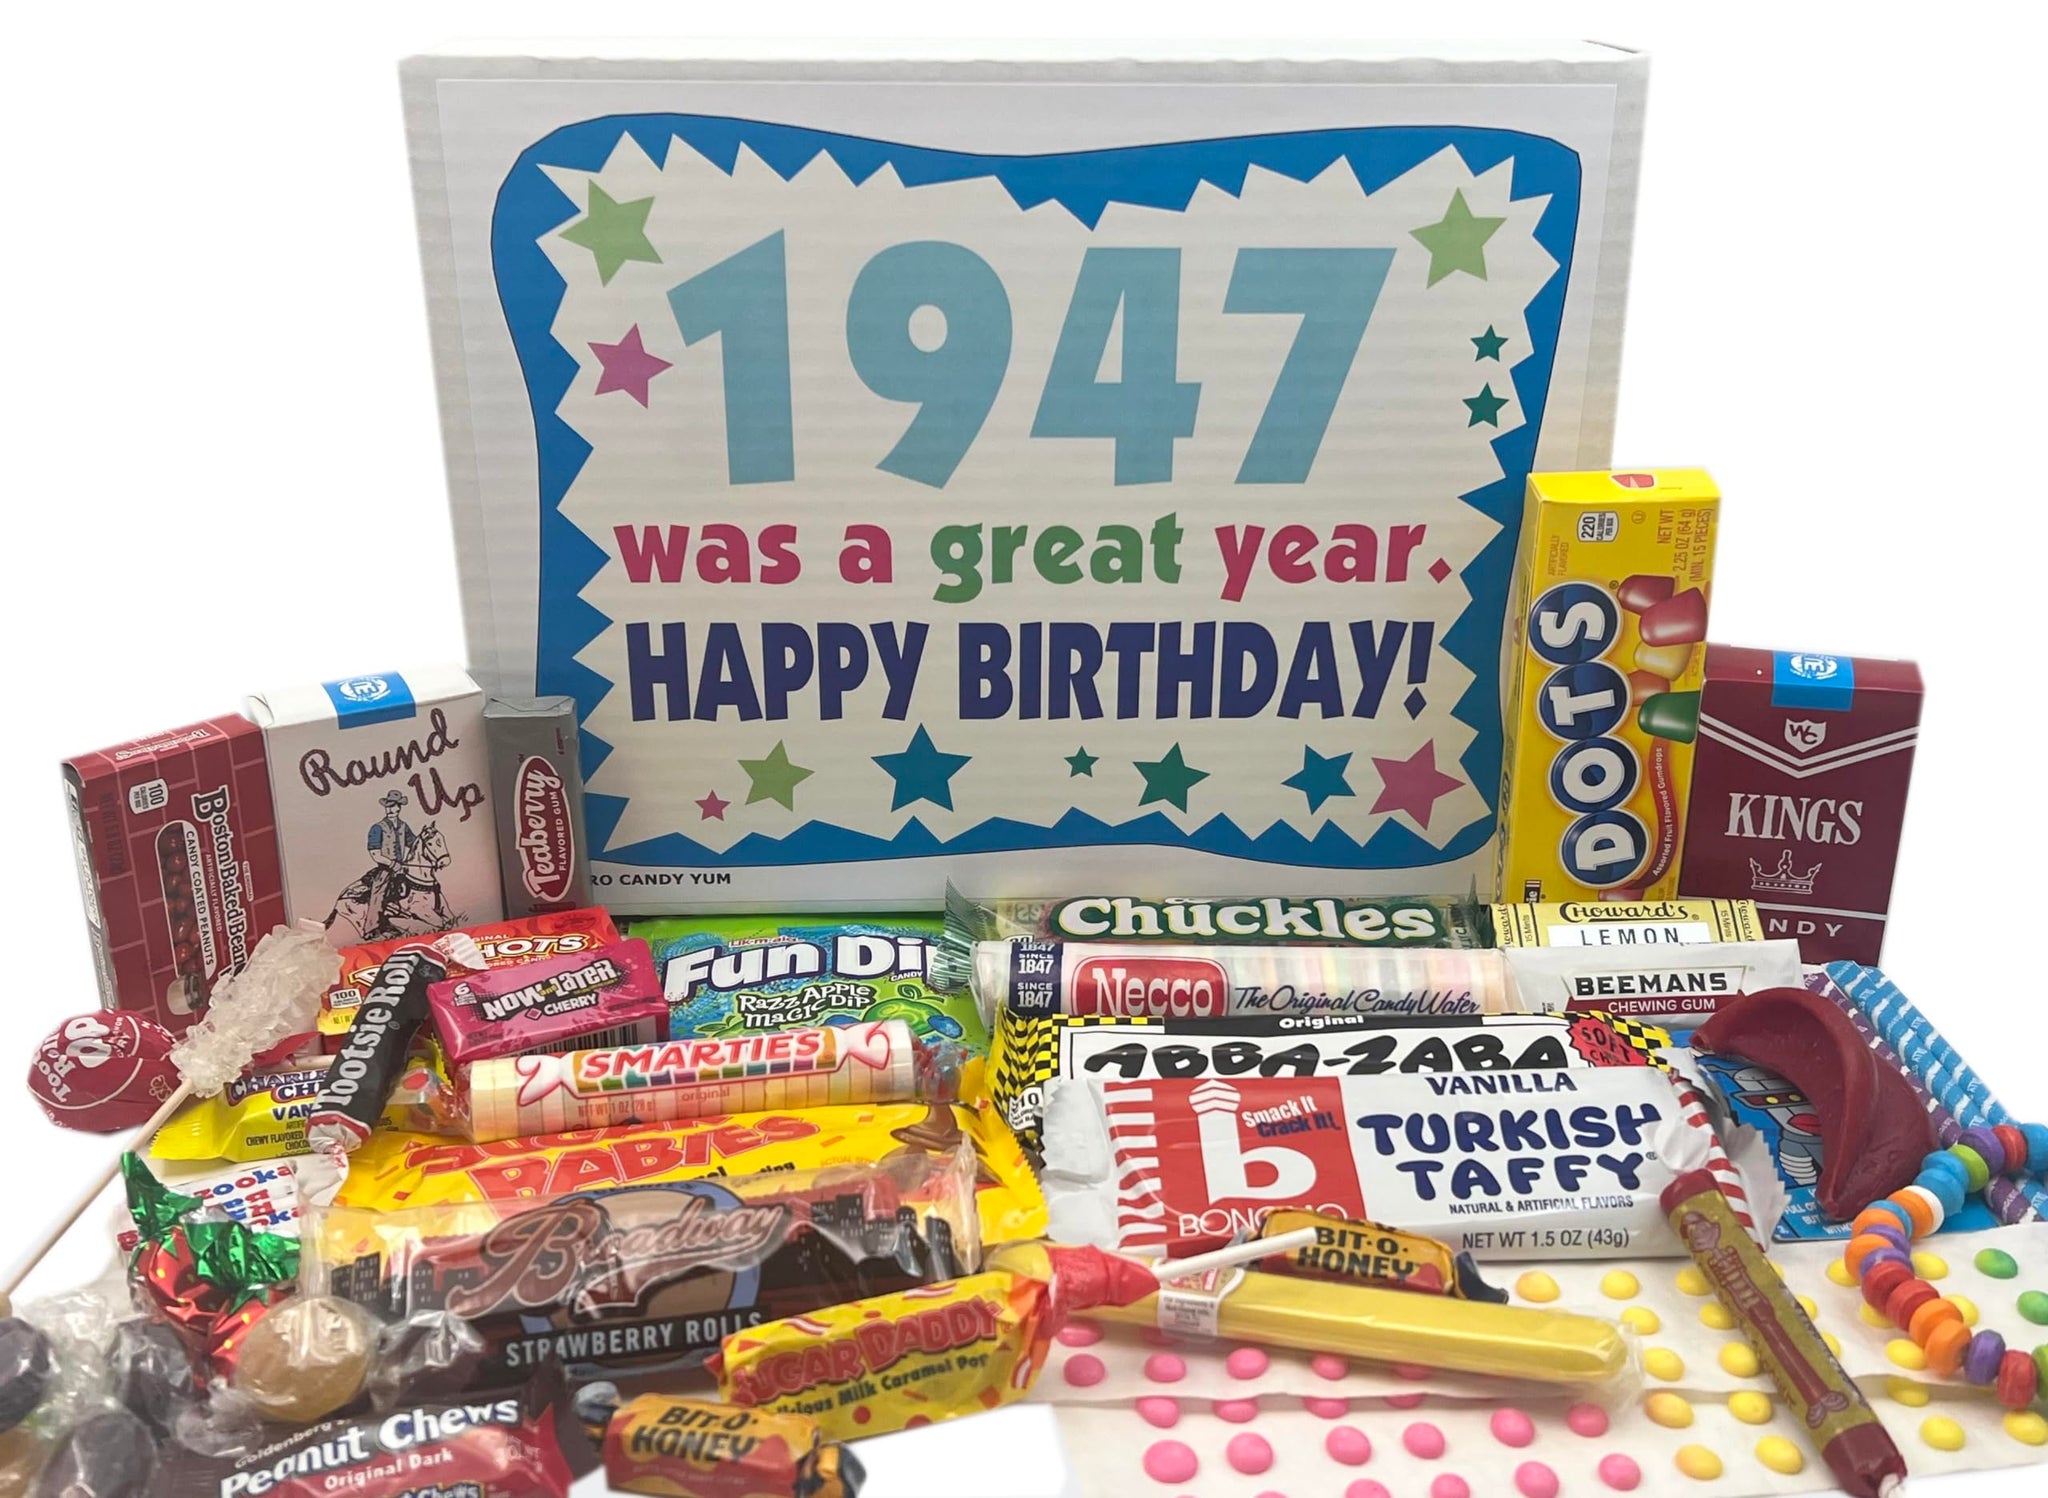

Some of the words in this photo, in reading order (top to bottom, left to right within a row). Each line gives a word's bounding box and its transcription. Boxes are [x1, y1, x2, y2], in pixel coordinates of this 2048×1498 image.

[667, 228, 1397, 489] 1947
[1581, 516, 1596, 538] 220
[1660, 510, 1674, 523] WT
[1657, 525, 1672, 545] NET
[613, 524, 799, 583] was
[839, 524, 893, 583] a
[931, 511, 1182, 603] great
[1215, 523, 1453, 602] year.
[626, 621, 929, 722] HAPPY
[958, 620, 1436, 722] BIRTHDAY!
[300, 708, 460, 797] Round
[1538, 601, 1637, 871] DOTS
[1655, 748, 1666, 789] Gumdrops
[148, 784, 165, 805] 100
[408, 767, 486, 823] Up
[551, 791, 563, 817] GUM
[1658, 790, 1673, 822] Flavored
[521, 769, 561, 895] Teaberry
[1664, 821, 1673, 843] Fruit
[1724, 792, 1864, 845] KINGS
[186, 830, 200, 867] CANDY
[556, 823, 567, 872] FLAVORED
[1652, 843, 1672, 876] Assorted
[192, 871, 206, 914] COATED
[590, 874, 613, 886] RO
[619, 874, 684, 886] CANDY
[689, 873, 731, 885] YUM
[199, 917, 214, 966] PEANUTS
[228, 920, 247, 968] Bean
[1580, 927, 1680, 945] LEMON
[1769, 918, 1844, 937] NDY
[664, 942, 820, 1002] Fun
[890, 971, 923, 983] CANDY
[1018, 959, 1054, 975] 1847
[333, 990, 357, 999] 100
[454, 983, 470, 995] 6
[1017, 982, 1053, 991] SINCE
[1017, 991, 1053, 1008] 1847
[1092, 968, 1214, 1017] Necco
[1235, 986, 1269, 1010] The
[1269, 985, 1356, 1015] Original
[1353, 989, 1418, 1014] Candy
[1417, 990, 1480, 1015] Wafer
[1574, 972, 1728, 996] BEEMANS
[544, 993, 599, 1017] CHERRY
[1608, 1000, 1677, 1014] CHEWING
[1681, 998, 1716, 1012] GUM
[312, 1007, 393, 1111] Tootsie
[362, 954, 420, 1007] Roll
[1278, 1015, 1364, 1030] Original
[583, 1031, 822, 1079] SMARTIES
[1084, 1033, 1569, 1079] ABBA-ZABA
[681, 1088, 730, 1102] original
[1425, 1072, 1578, 1095] VANILLA
[1241, 1100, 1301, 1128] Smack
[1256, 1117, 1312, 1138] Crack
[1356, 1103, 1662, 1156] TURKISH
[245, 1134, 268, 1146] CHEWY
[270, 1131, 304, 1143] FLAVORED
[1396, 1152, 1643, 1201] TAFFY
[1450, 1202, 1502, 1215] NATURAL
[1505, 1201, 1515, 1212] &
[1517, 1197, 1580, 1213] ARTIFICIAL
[1581, 1195, 1634, 1209] FLAVORS
[1462, 1233, 1495, 1249] NET
[1498, 1231, 1526, 1248] WT
[1531, 1230, 1556, 1247] 1.5
[1560, 1230, 1583, 1246] OZ
[1587, 1228, 1630, 1248] (43g)
[446, 1198, 786, 1318] Broadway
[1297, 1246, 1415, 1279] HONEY
[506, 1322, 673, 1368] STRAWBERRY
[856, 1295, 1004, 1375] DADDY
[837, 1380, 878, 1406] Milk
[881, 1357, 953, 1391] Caramel
[219, 1425, 370, 1498] Peanut
[378, 1399, 520, 1451] Chews
[632, 1424, 760, 1463] HONEY
[324, 1461, 402, 1491] Original
[408, 1449, 453, 1472] Dark
